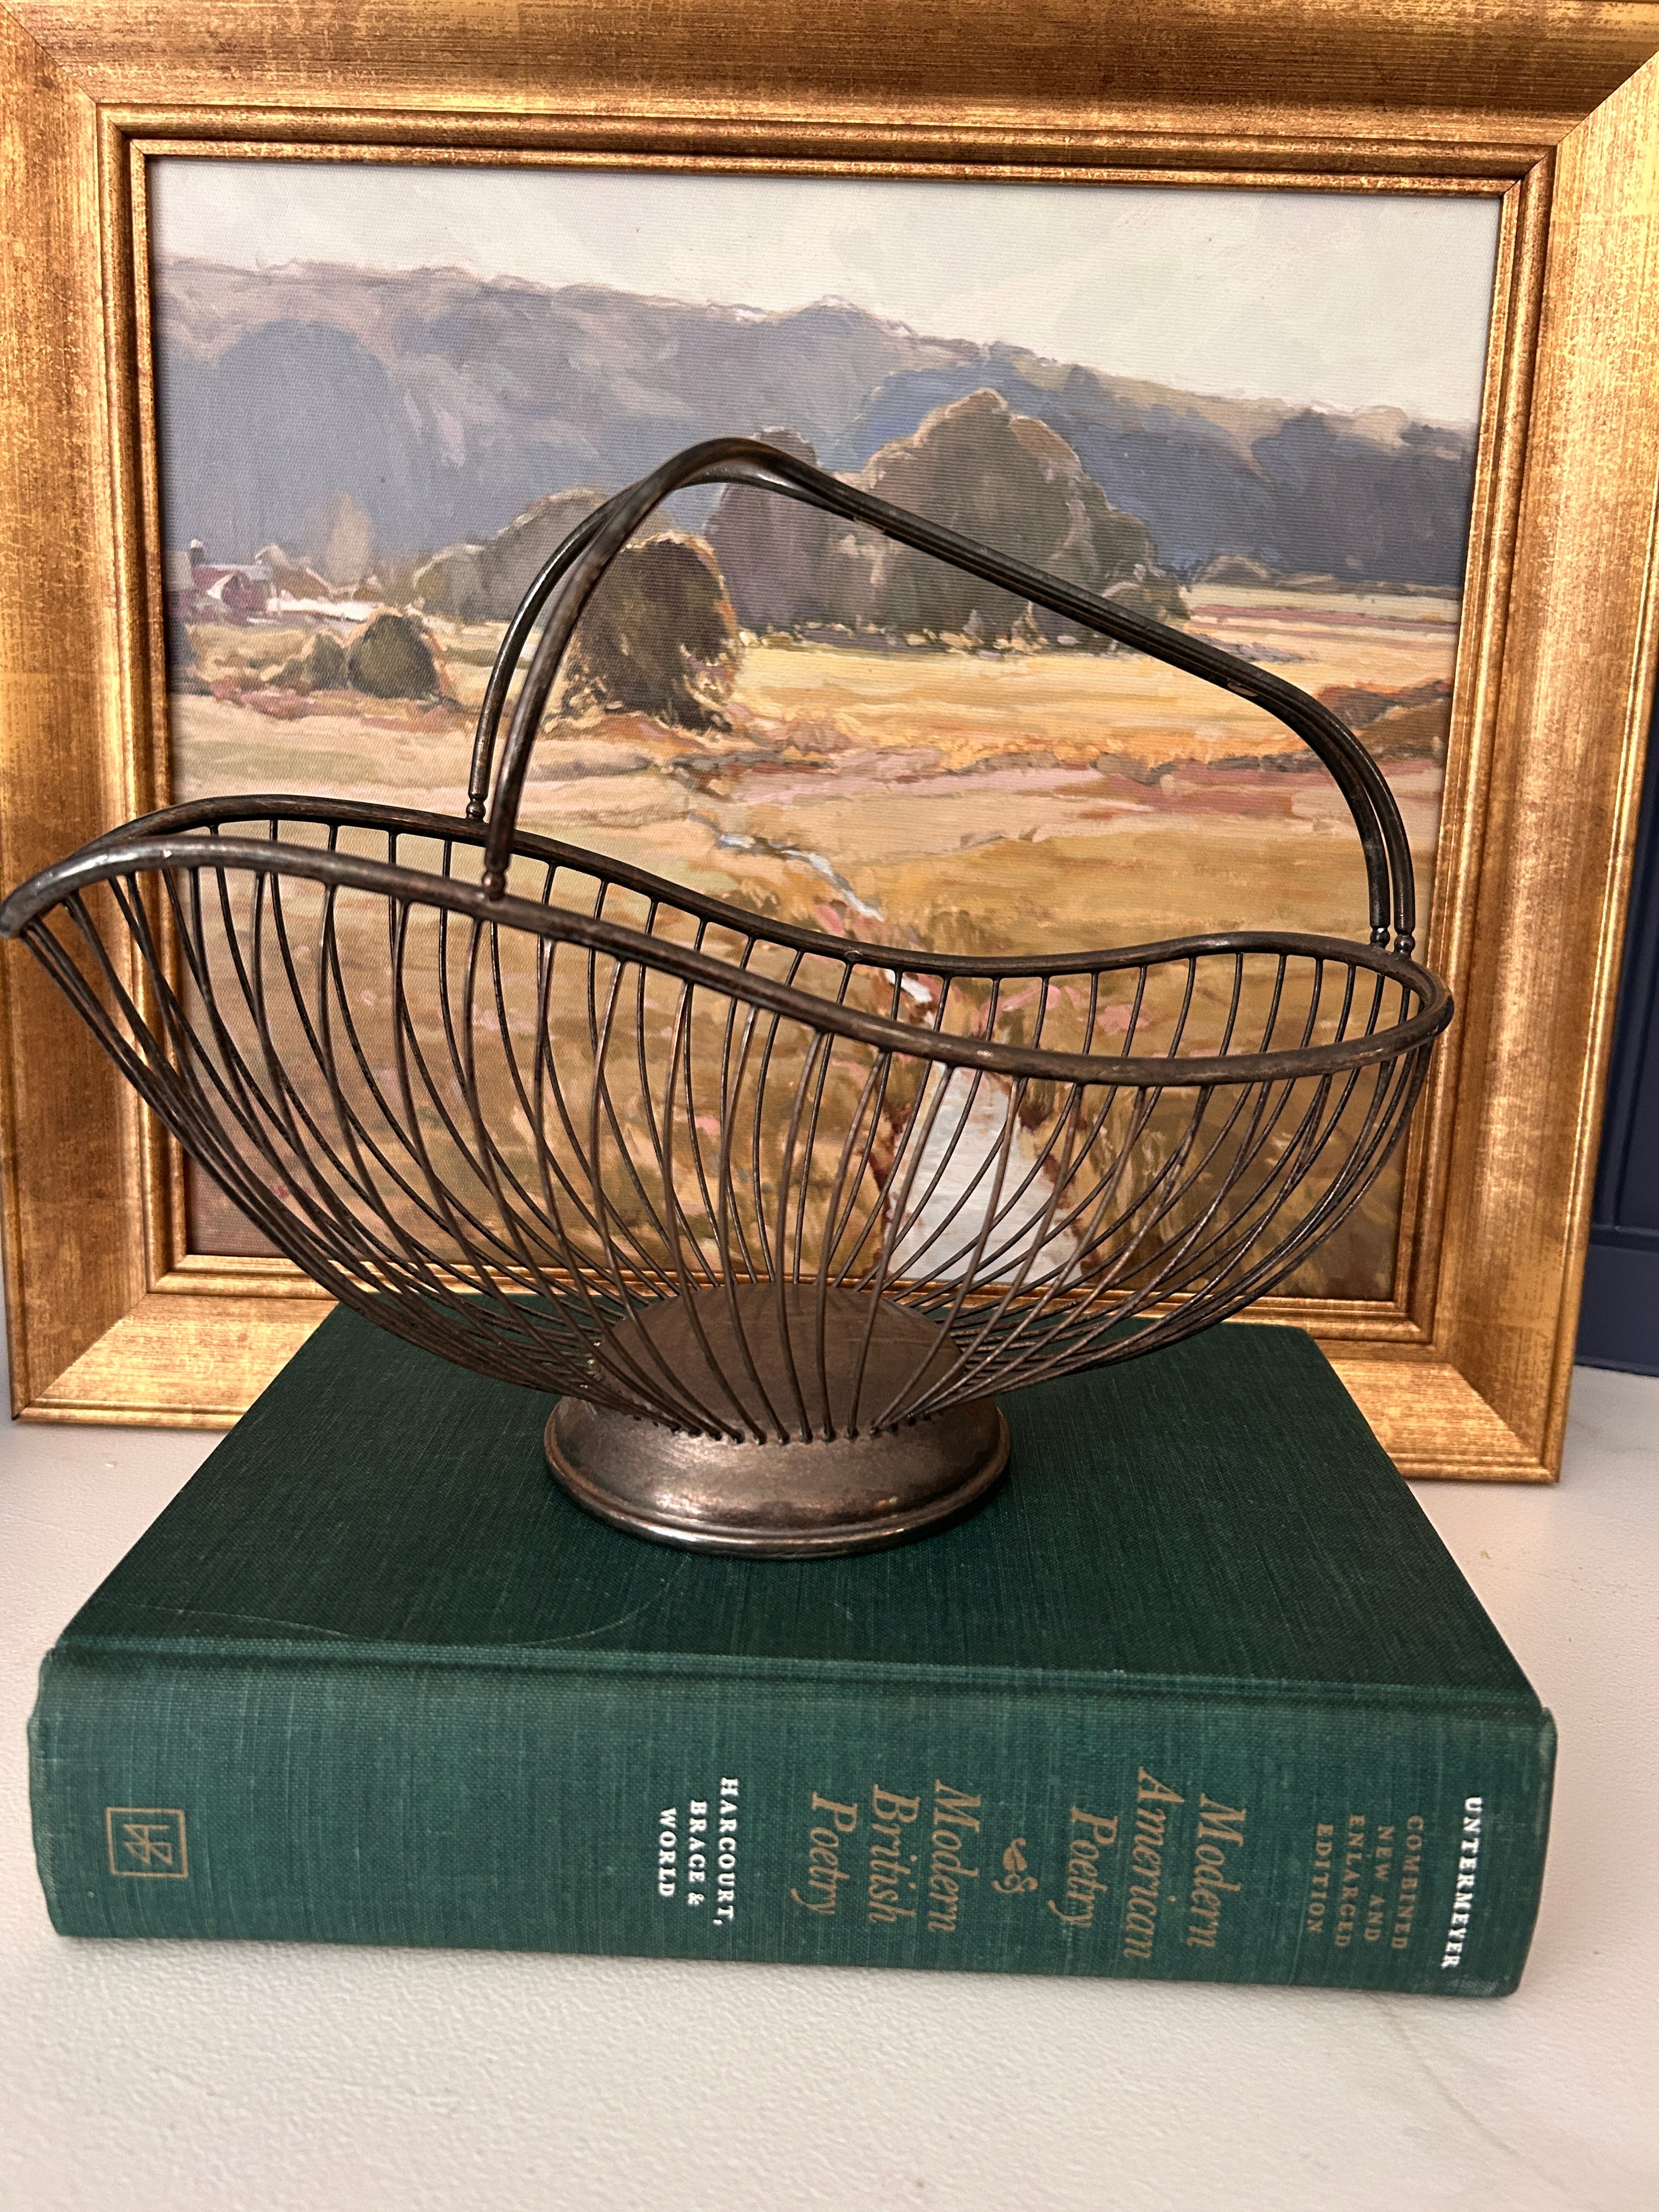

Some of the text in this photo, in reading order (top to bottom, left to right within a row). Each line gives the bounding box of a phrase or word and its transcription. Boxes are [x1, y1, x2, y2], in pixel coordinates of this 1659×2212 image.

[658, 1808, 677, 1898] WORLD
[687, 1800, 707, 1906] BRACE &
[714, 1778, 739, 1926] HARCOURT,
[791, 1791, 858, 1916] Poetry
[868, 1784, 920, 1923] British
[928, 1779, 981, 1932] Modern
[1048, 1805, 1118, 1928] Poetry
[1123, 1766, 1185, 1959] American
[1187, 1793, 1246, 1948] Modern
[1307, 1824, 1333, 1933] EDITION
[1335, 1814, 1365, 1946] ENLARGED
[1364, 1825, 1395, 1941] NEW AND
[1391, 1815, 1424, 1949] COMBINED
[1441, 1796, 1482, 1970] UNTERMEYER
